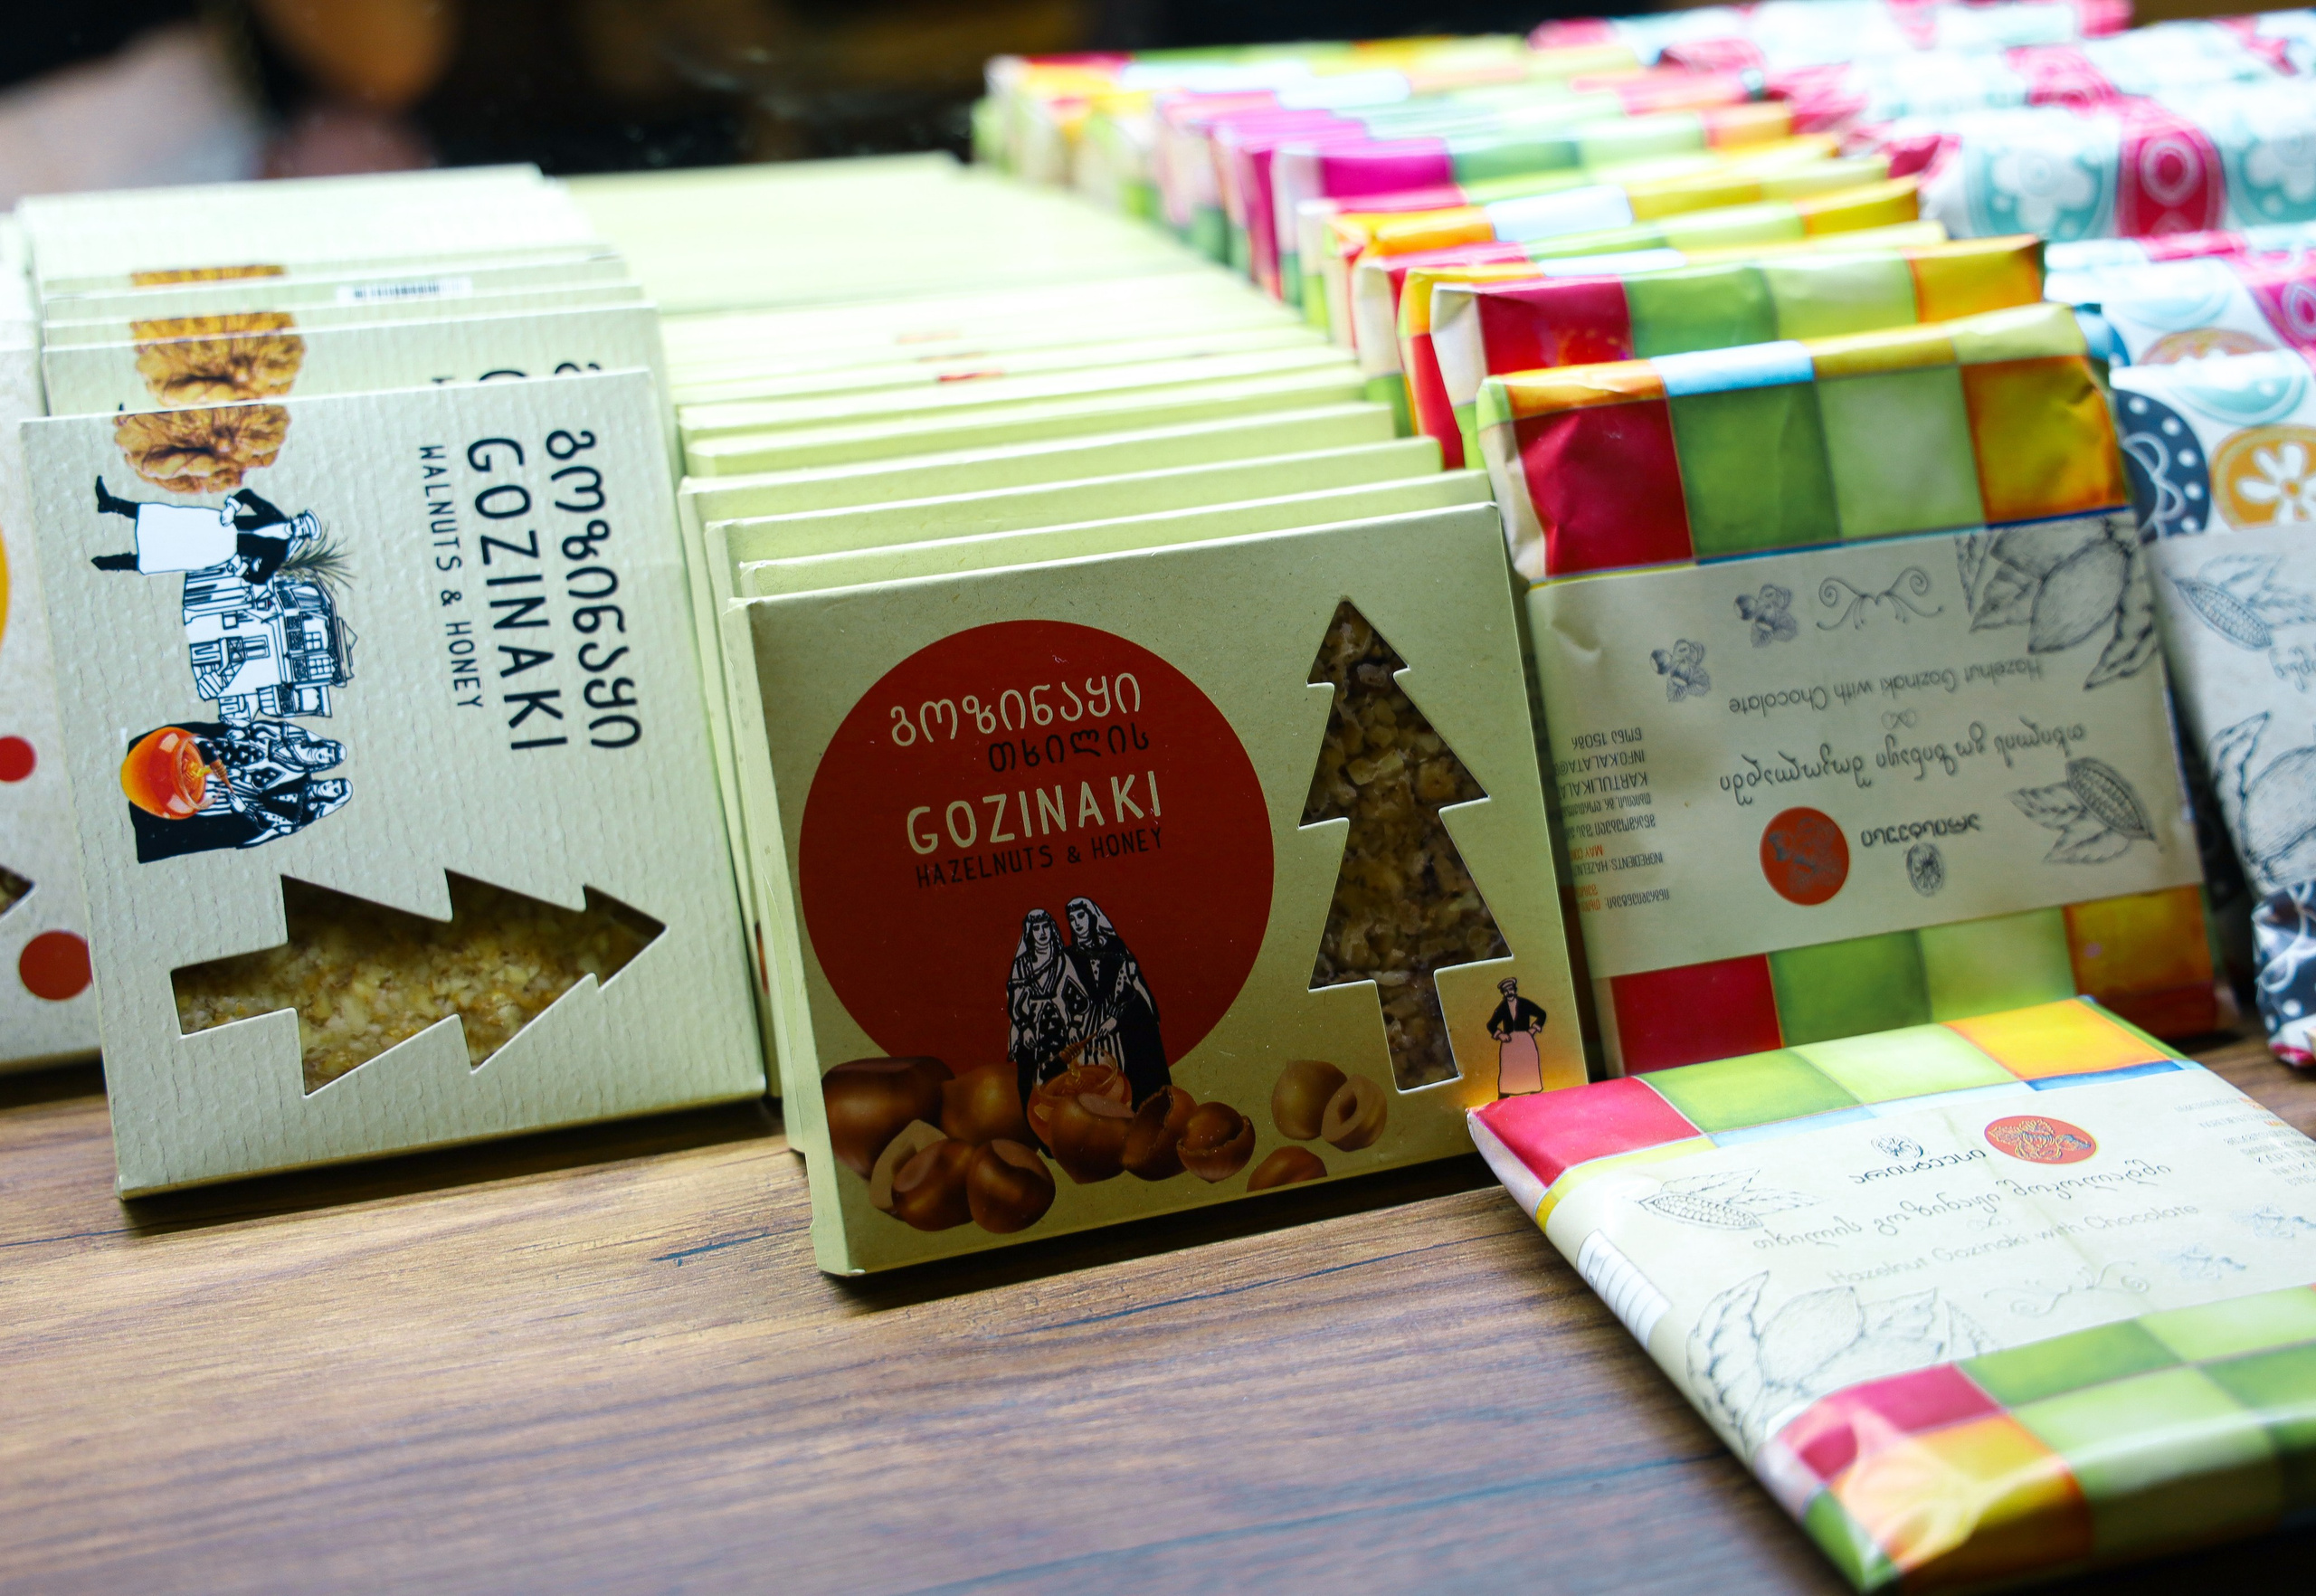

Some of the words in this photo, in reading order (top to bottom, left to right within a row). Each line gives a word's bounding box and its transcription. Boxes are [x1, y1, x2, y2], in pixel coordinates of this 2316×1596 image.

[419, 443, 463, 573] WALNUTS
[440, 589, 463, 608] &
[466, 436, 569, 751] GOZINAKI
[546, 429, 643, 750] გოზინაყი
[445, 621, 484, 709] HONEY
[1833, 679, 1874, 701] with
[1879, 667, 1958, 694] Gozinaki
[1962, 658, 2044, 684] Hazelnut
[889, 672, 1142, 746] გოზინაყი
[1729, 685, 1827, 715] Chocolate
[906, 770, 1163, 855] GOZINAKI
[915, 844, 1054, 889] HAZELNUTS
[1066, 845, 1083, 865] &
[1091, 826, 1163, 860] HONEY
[1931, 1233, 2029, 1262] Gozinaki
[2036, 1221, 2082, 1240] with
[2083, 1203, 2200, 1230] Chocolate
